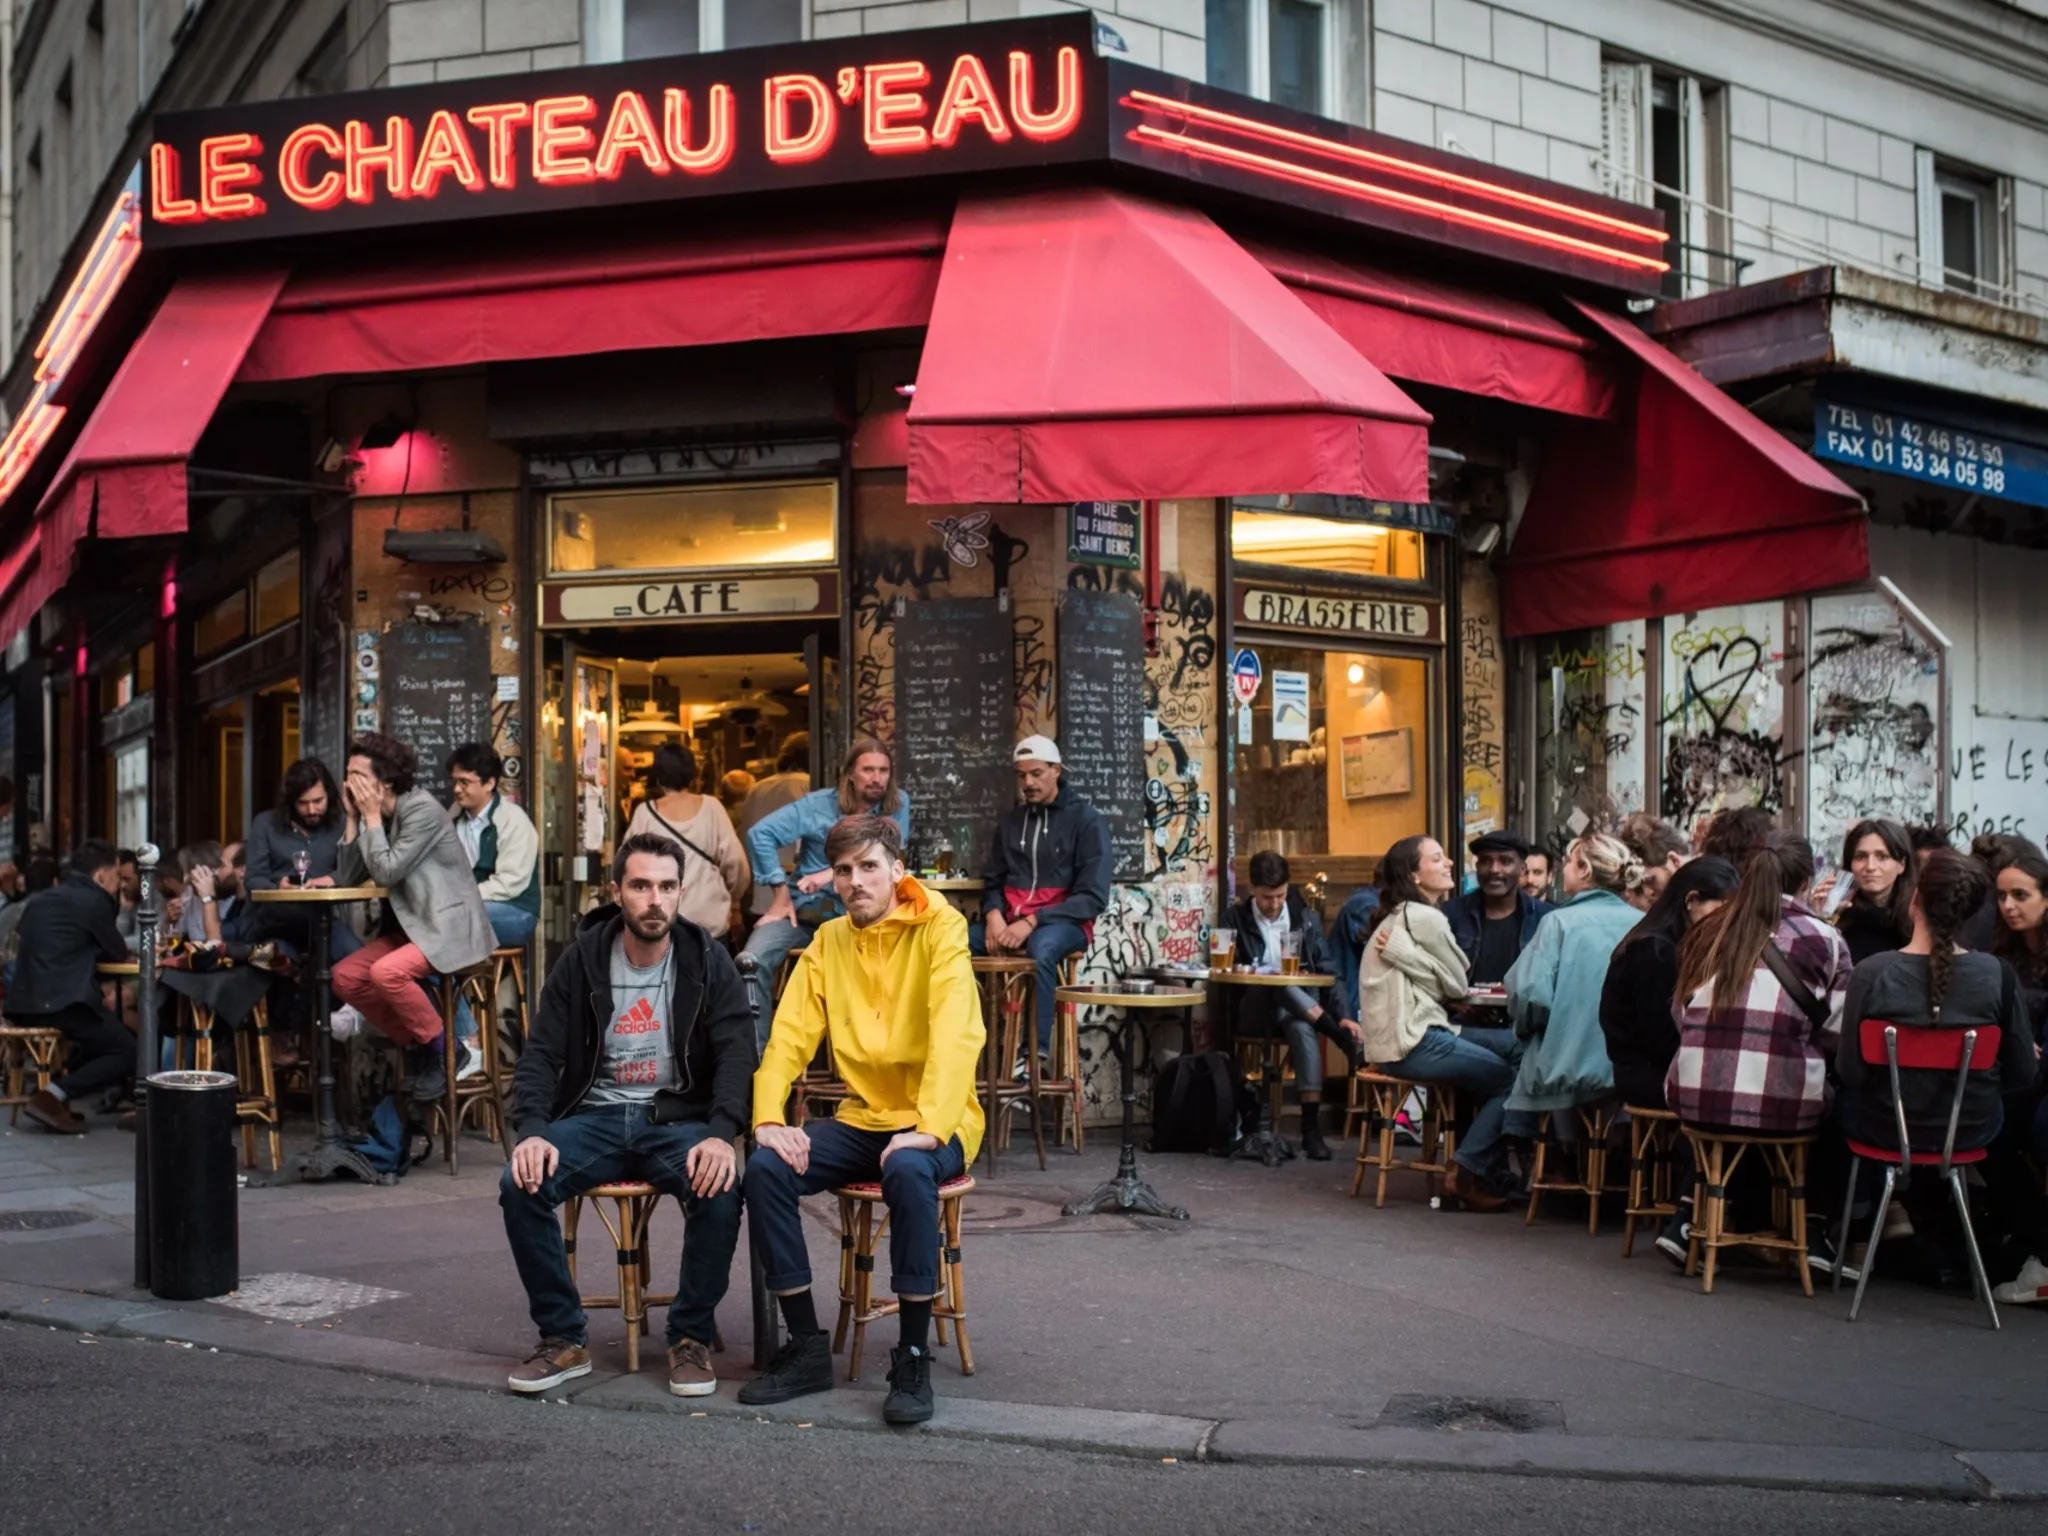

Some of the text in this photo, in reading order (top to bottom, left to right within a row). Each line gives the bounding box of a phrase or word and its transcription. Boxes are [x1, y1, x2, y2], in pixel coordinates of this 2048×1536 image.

[150, 133, 266, 224] LE
[278, 86, 735, 210] CHATEAU
[1828, 405, 1862, 431] TEL
[1872, 414, 1893, 439] 01
[1900, 421, 1924, 447] 42
[1955, 435, 1979, 461] 52
[1828, 431, 2005, 493] FAX 01 53 34 05 98
[1093, 502, 1118, 518] RUE
[1080, 534, 1131, 557] SAINT DENIS
[1259, 593, 1416, 634] BRASSERIE
[613, 1019, 661, 1035] adidas
[616, 1060, 657, 1072] SINCE
